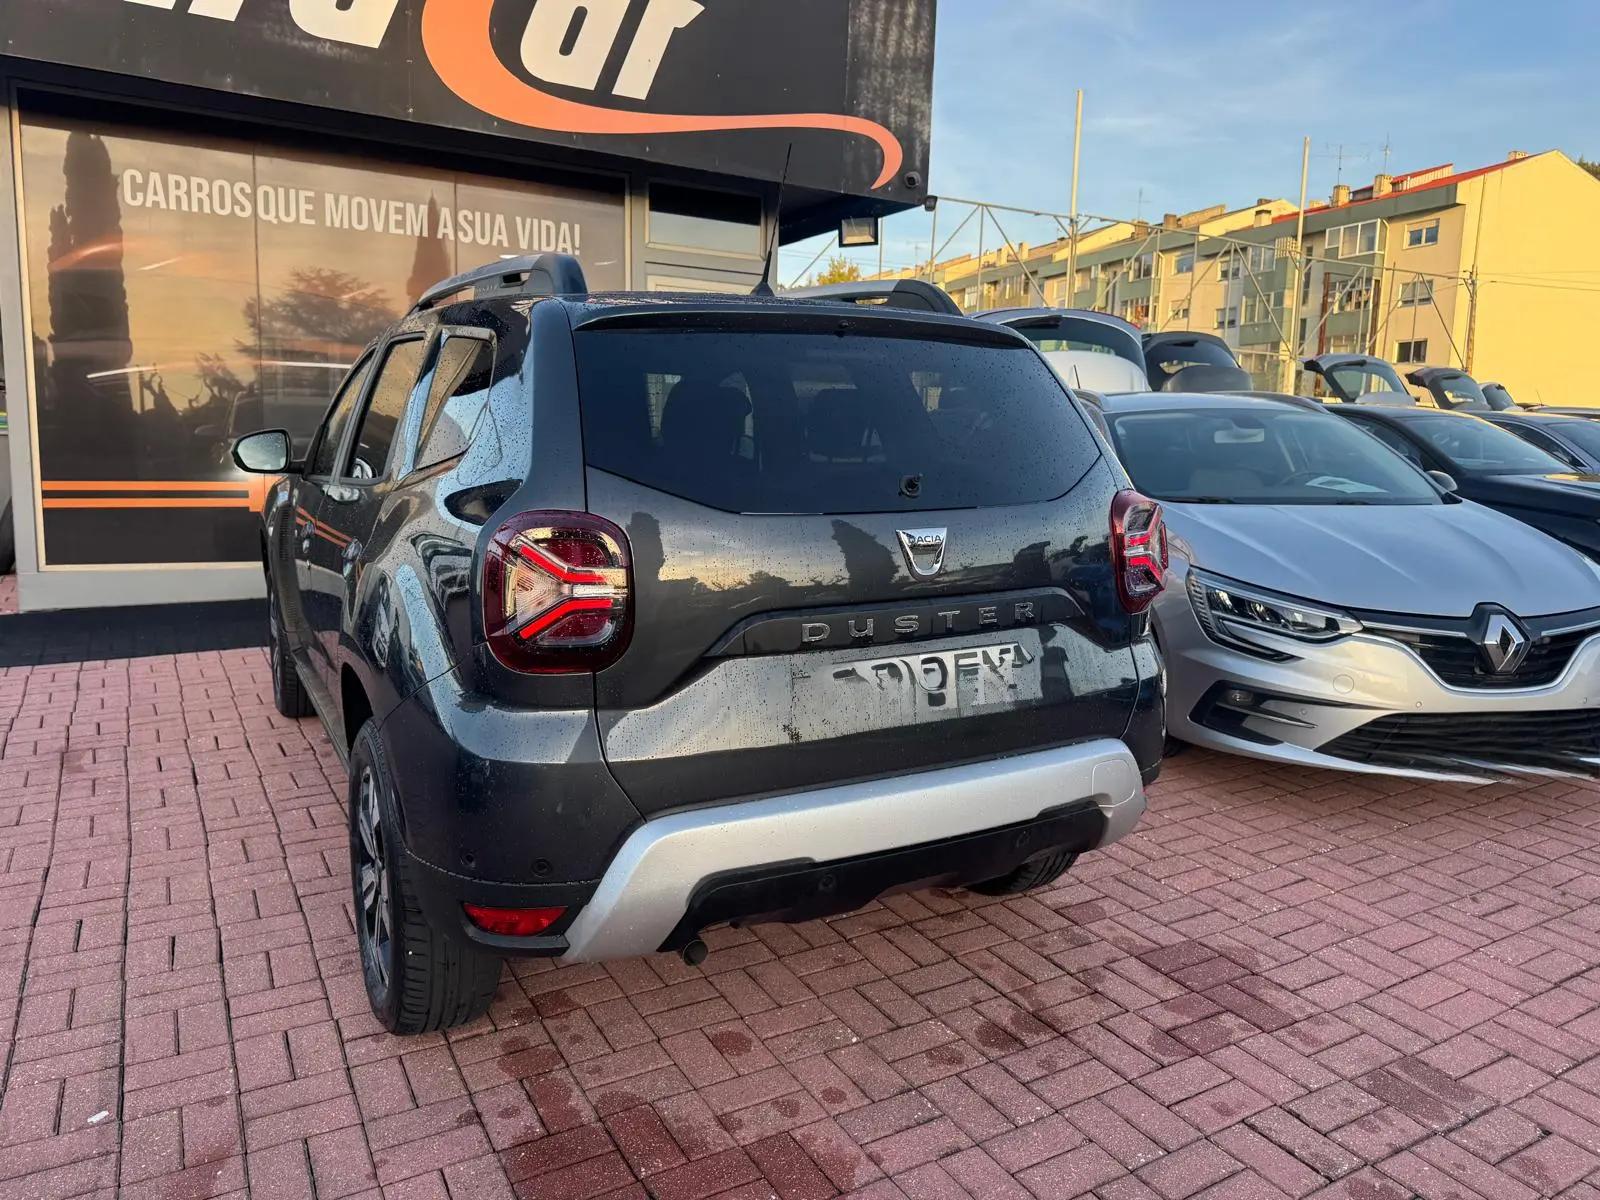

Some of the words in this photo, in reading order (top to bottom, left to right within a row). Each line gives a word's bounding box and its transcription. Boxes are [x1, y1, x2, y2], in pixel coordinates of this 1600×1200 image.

[122, 168, 253, 218] CARROS
[256, 184, 316, 224] QUE
[324, 193, 429, 238] MOVEM
[515, 215, 581, 256] VIDA!
[908, 534, 942, 544] DACIA
[801, 601, 1034, 643] DUSTER
